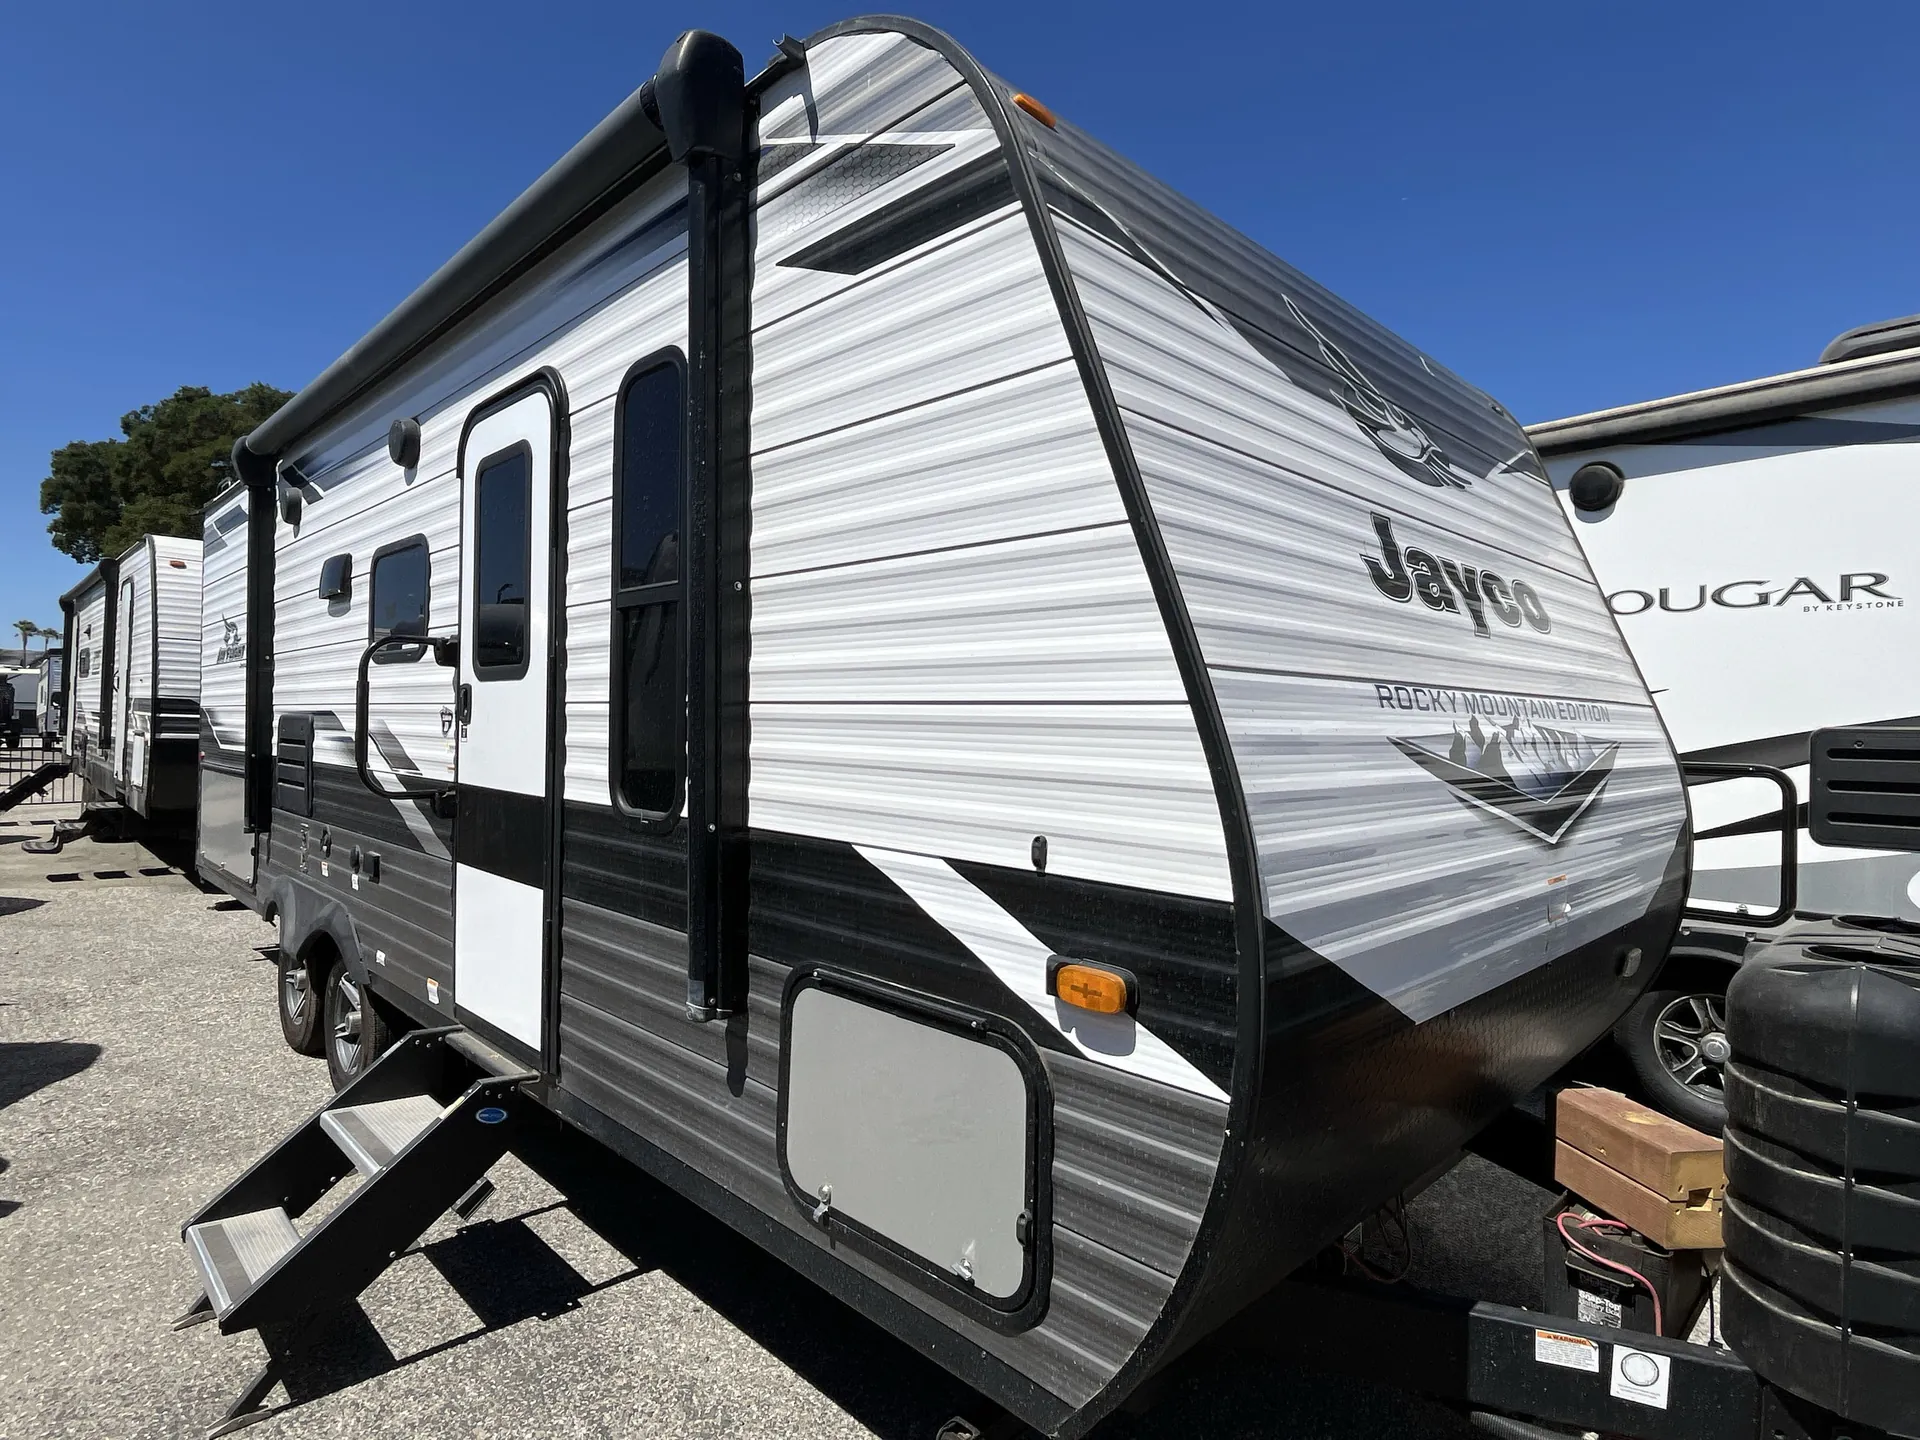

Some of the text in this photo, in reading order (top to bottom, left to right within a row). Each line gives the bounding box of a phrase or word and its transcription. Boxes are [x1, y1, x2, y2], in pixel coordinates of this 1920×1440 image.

[1360, 510, 1552, 640] Jayco
[1602, 572, 1904, 616] OUGAR
[1803, 600, 1904, 613] BY KEYSTONE
[1373, 684, 1611, 722] ROCKY MOUNTAIN EDITION
[1552, 1334, 1588, 1346] WARNING
